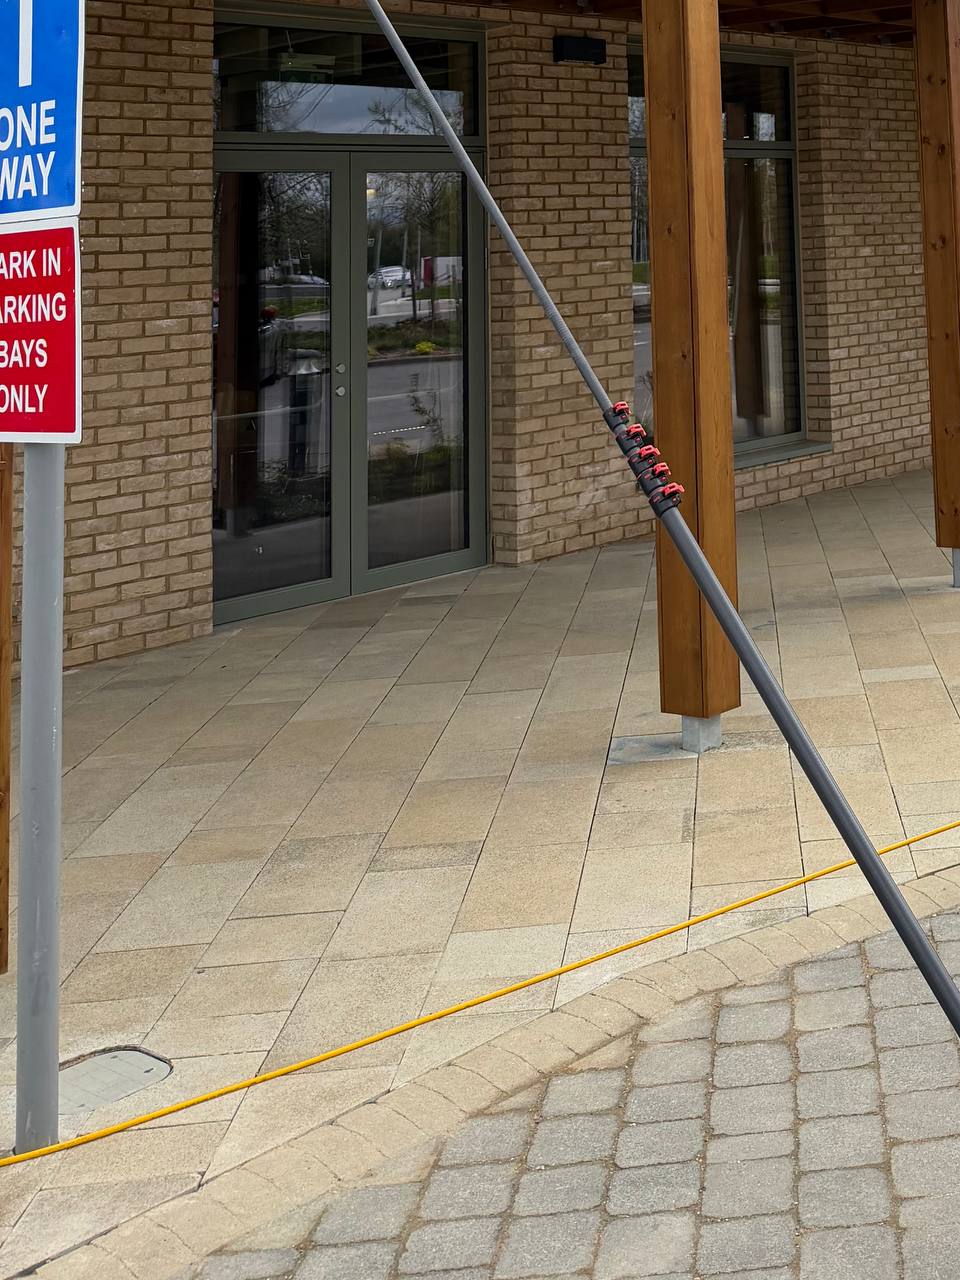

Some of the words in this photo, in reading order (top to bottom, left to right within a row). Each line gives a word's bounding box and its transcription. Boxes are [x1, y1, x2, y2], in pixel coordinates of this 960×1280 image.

[0, 99, 56, 151] ONE
[0, 151, 56, 200] WAY
[0, 249, 37, 280] ARK
[42, 247, 61, 277] IN
[0, 292, 67, 324] RKING
[0, 338, 48, 368] BAYS
[0, 384, 49, 413] ONLY
